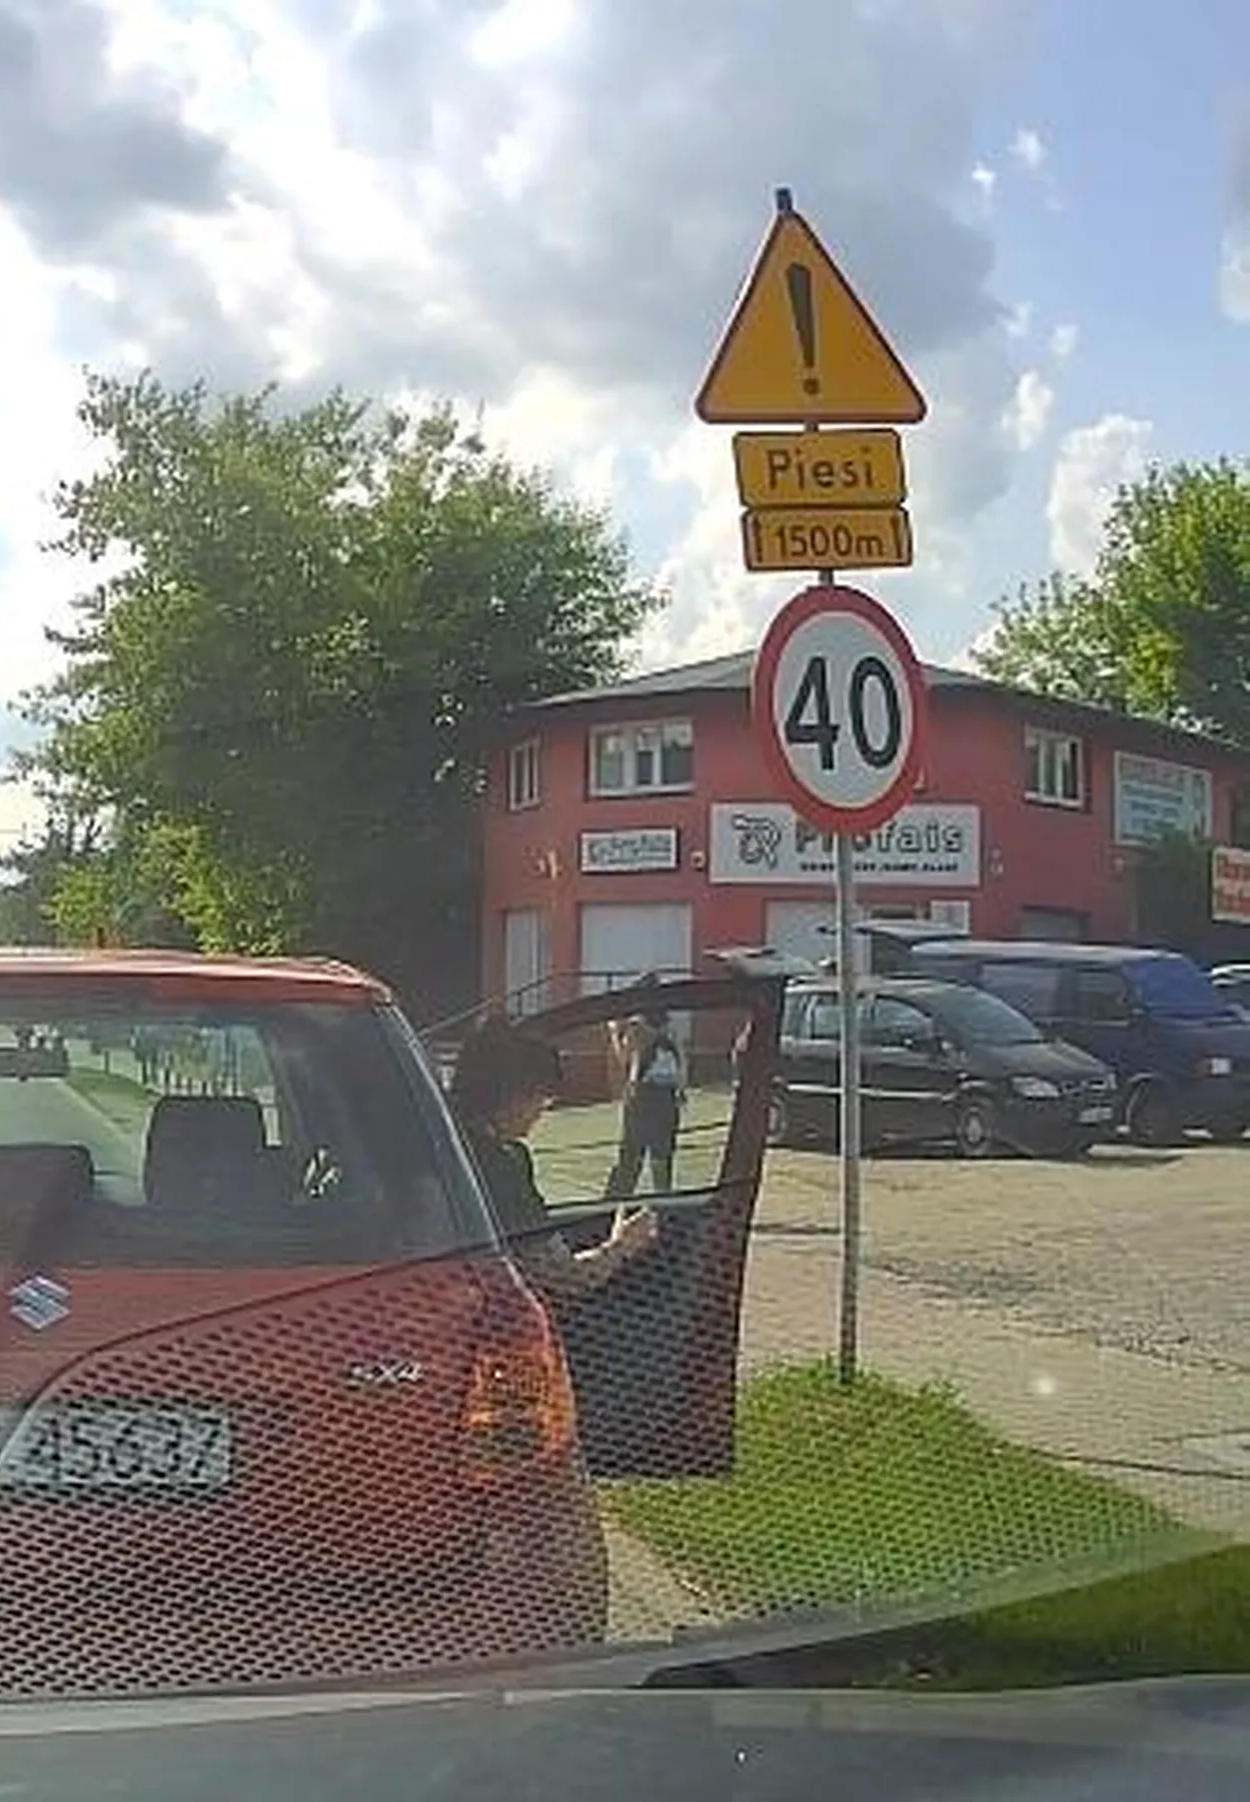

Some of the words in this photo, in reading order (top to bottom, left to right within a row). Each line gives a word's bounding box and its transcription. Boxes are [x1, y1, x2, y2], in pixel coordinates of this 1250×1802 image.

[767, 446, 873, 490] Piesi
[775, 523, 885, 558] 1500m
[785, 656, 902, 770] 40
